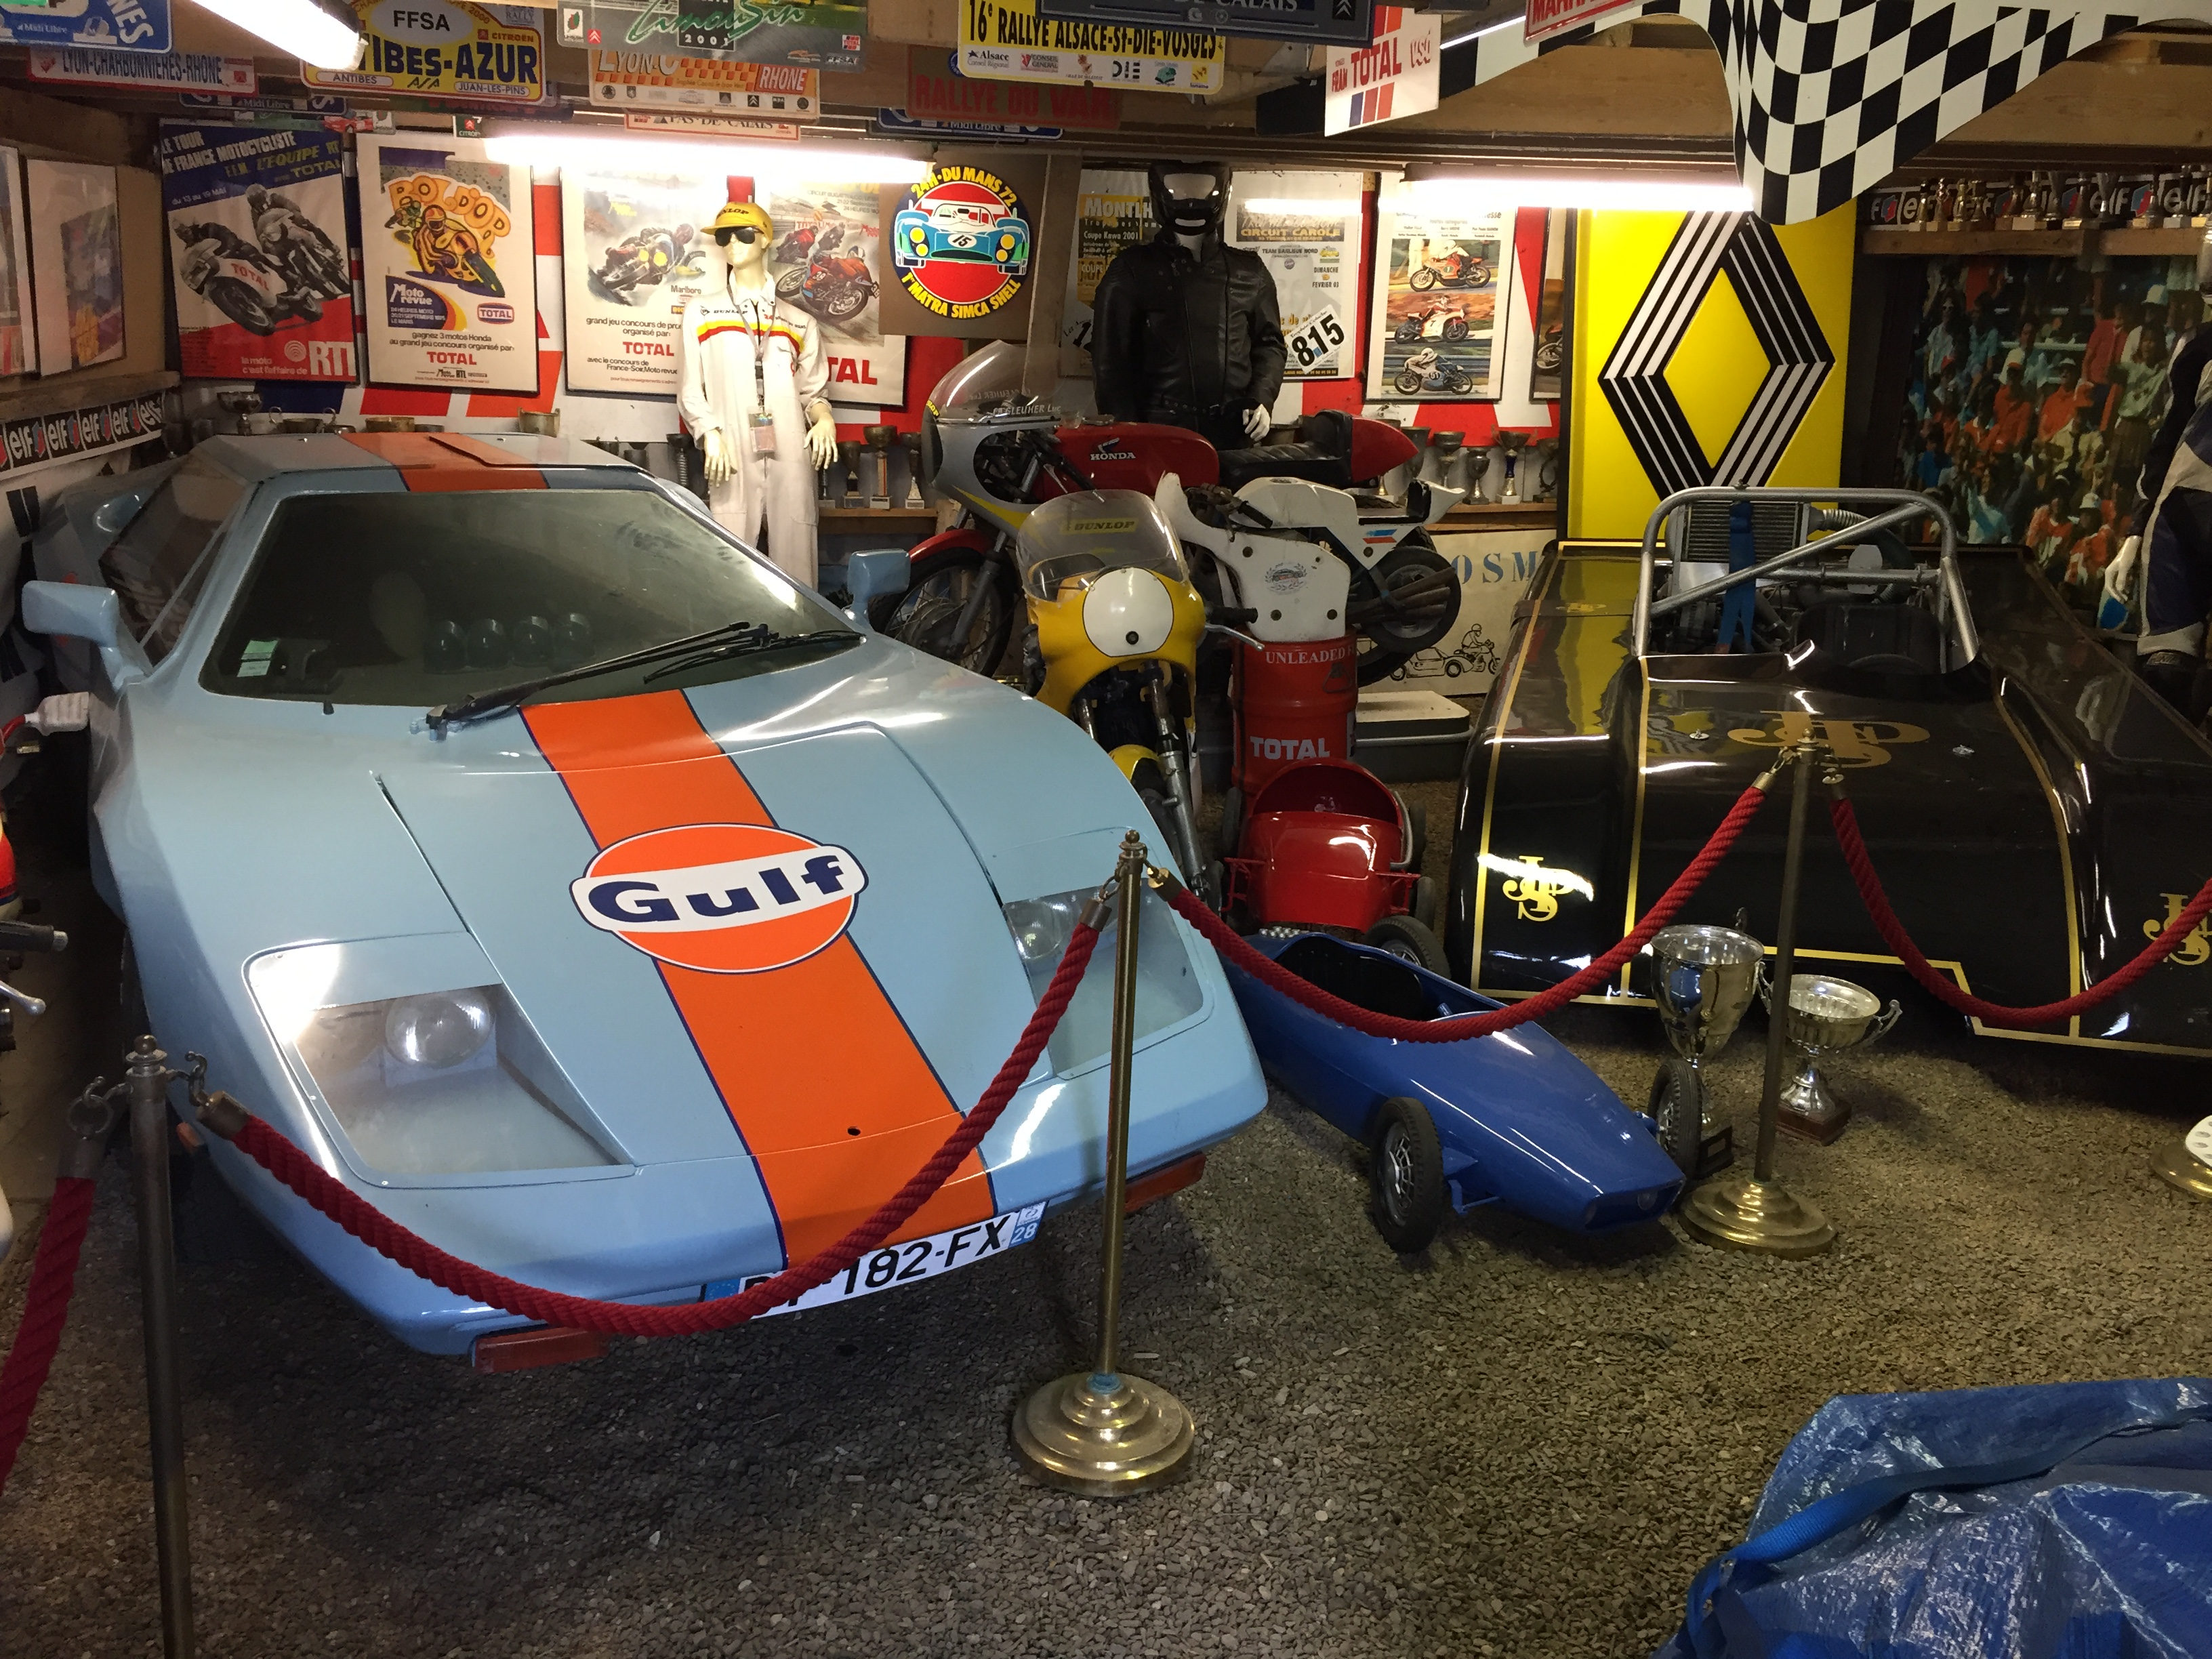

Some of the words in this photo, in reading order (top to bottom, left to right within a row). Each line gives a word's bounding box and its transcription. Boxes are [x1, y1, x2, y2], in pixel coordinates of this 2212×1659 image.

[393, 9, 451, 31] FFSA
[998, 7, 1049, 47] RALLYE
[684, 34, 729, 47] 2001
[979, 50, 1010, 62] Alsace
[1351, 37, 1402, 89] TOTAL
[333, 74, 377, 85] ANTIBES
[759, 66, 807, 91] RHONE
[458, 81, 526, 96] JUAN-LES-PINS
[915, 74, 998, 115] RALLYE
[1008, 83, 1040, 117] DU
[172, 131, 205, 151] TOUR
[173, 148, 217, 172] FRANCE
[216, 130, 297, 162] MOTOCYCLISTE
[941, 166, 962, 182] DU
[962, 166, 1003, 194] MANS
[998, 185, 1017, 207] 72
[1084, 230, 1102, 241] Coupe
[1122, 231, 1139, 241] 2001
[1241, 228, 1288, 237] CIRCUIT
[1292, 228, 1341, 237] CAROLE
[952, 234, 973, 247] 15
[1082, 264, 1104, 273] COUPE
[230, 263, 270, 291] TOTAL
[813, 271, 826, 282] 38
[390, 283, 425, 303] Moto
[670, 285, 702, 295] Marlboro
[401, 296, 433, 306] revue
[907, 282, 948, 316] MATRA
[950, 302, 991, 319] SIMCA
[989, 279, 1022, 310] SHELL
[480, 308, 512, 318] TOTAL
[586, 317, 608, 325] grand
[608, 318, 620, 327] jeu
[621, 319, 656, 328] concours
[412, 331, 438, 340] gagnez
[622, 328, 655, 337] organisé
[1291, 313, 1345, 367] 815
[396, 339, 420, 347] grand
[468, 342, 498, 351] organisé
[622, 341, 675, 357] TOTAL
[426, 351, 477, 365] TOTAL
[609, 358, 640, 366] concours
[643, 365, 661, 373] Moto
[82, 413, 100, 443] elf
[112, 407, 130, 436] elf
[47, 419, 68, 451] elf
[9, 426, 33, 460] elf
[1090, 451, 1136, 461] HONDA
[1073, 520, 1136, 531] DUNLOP
[1265, 647, 1346, 664] UNLEADED
[1250, 737, 1330, 761] TOTAL
[588, 854, 845, 923] Gulf
[1012, 1221, 1038, 1244] 28
